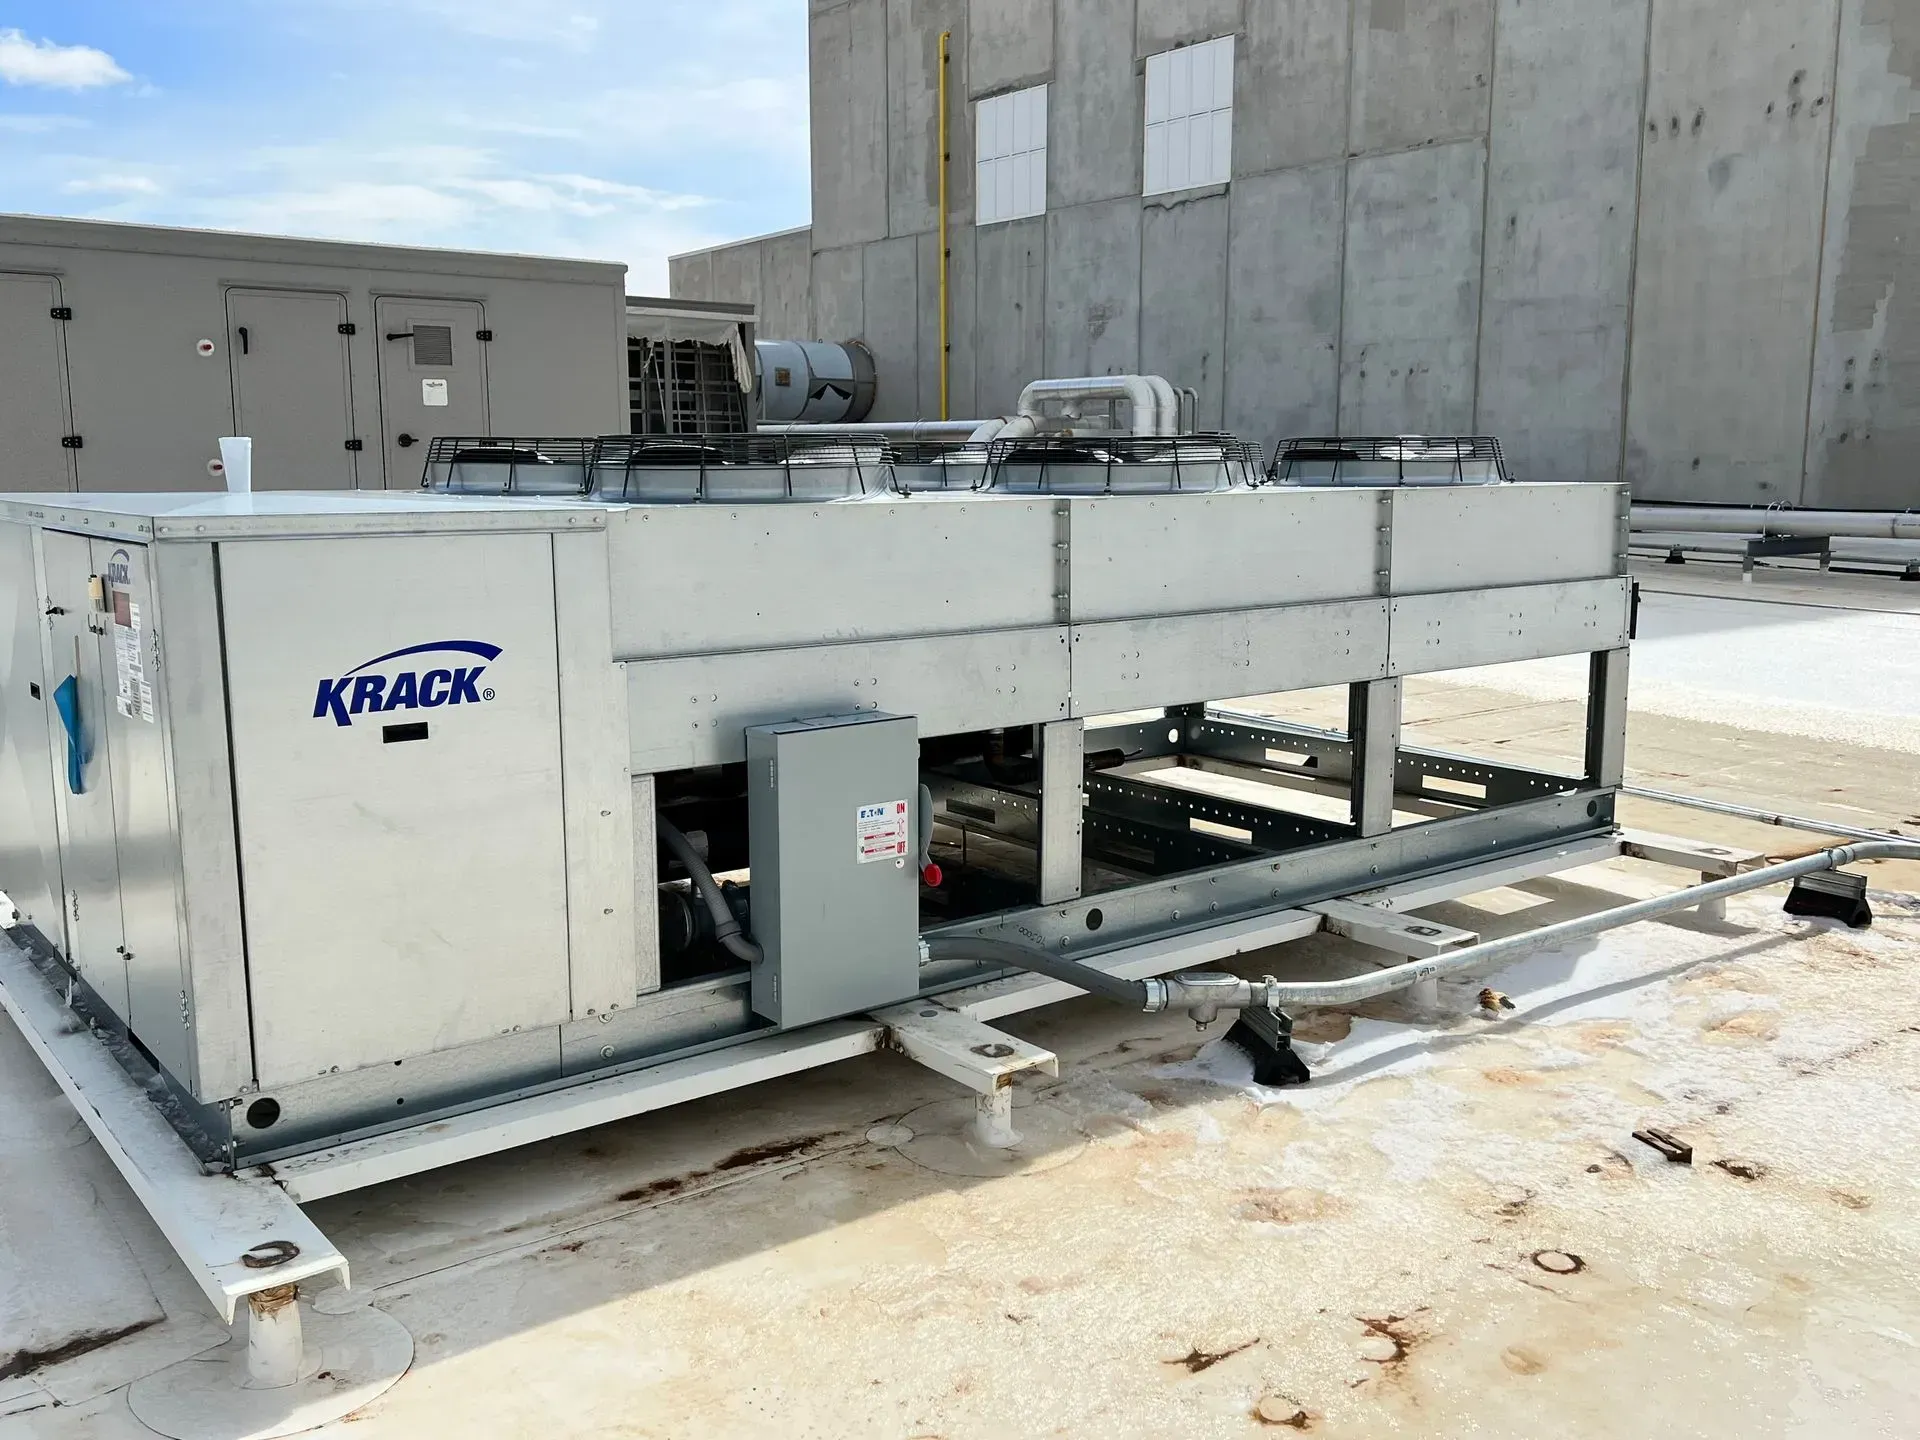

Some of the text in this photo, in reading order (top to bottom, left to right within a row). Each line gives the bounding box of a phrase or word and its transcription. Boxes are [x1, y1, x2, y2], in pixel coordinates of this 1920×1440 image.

[108, 562, 129, 588] KRACK
[896, 803, 905, 814] ON
[896, 841, 906, 854] OFF
